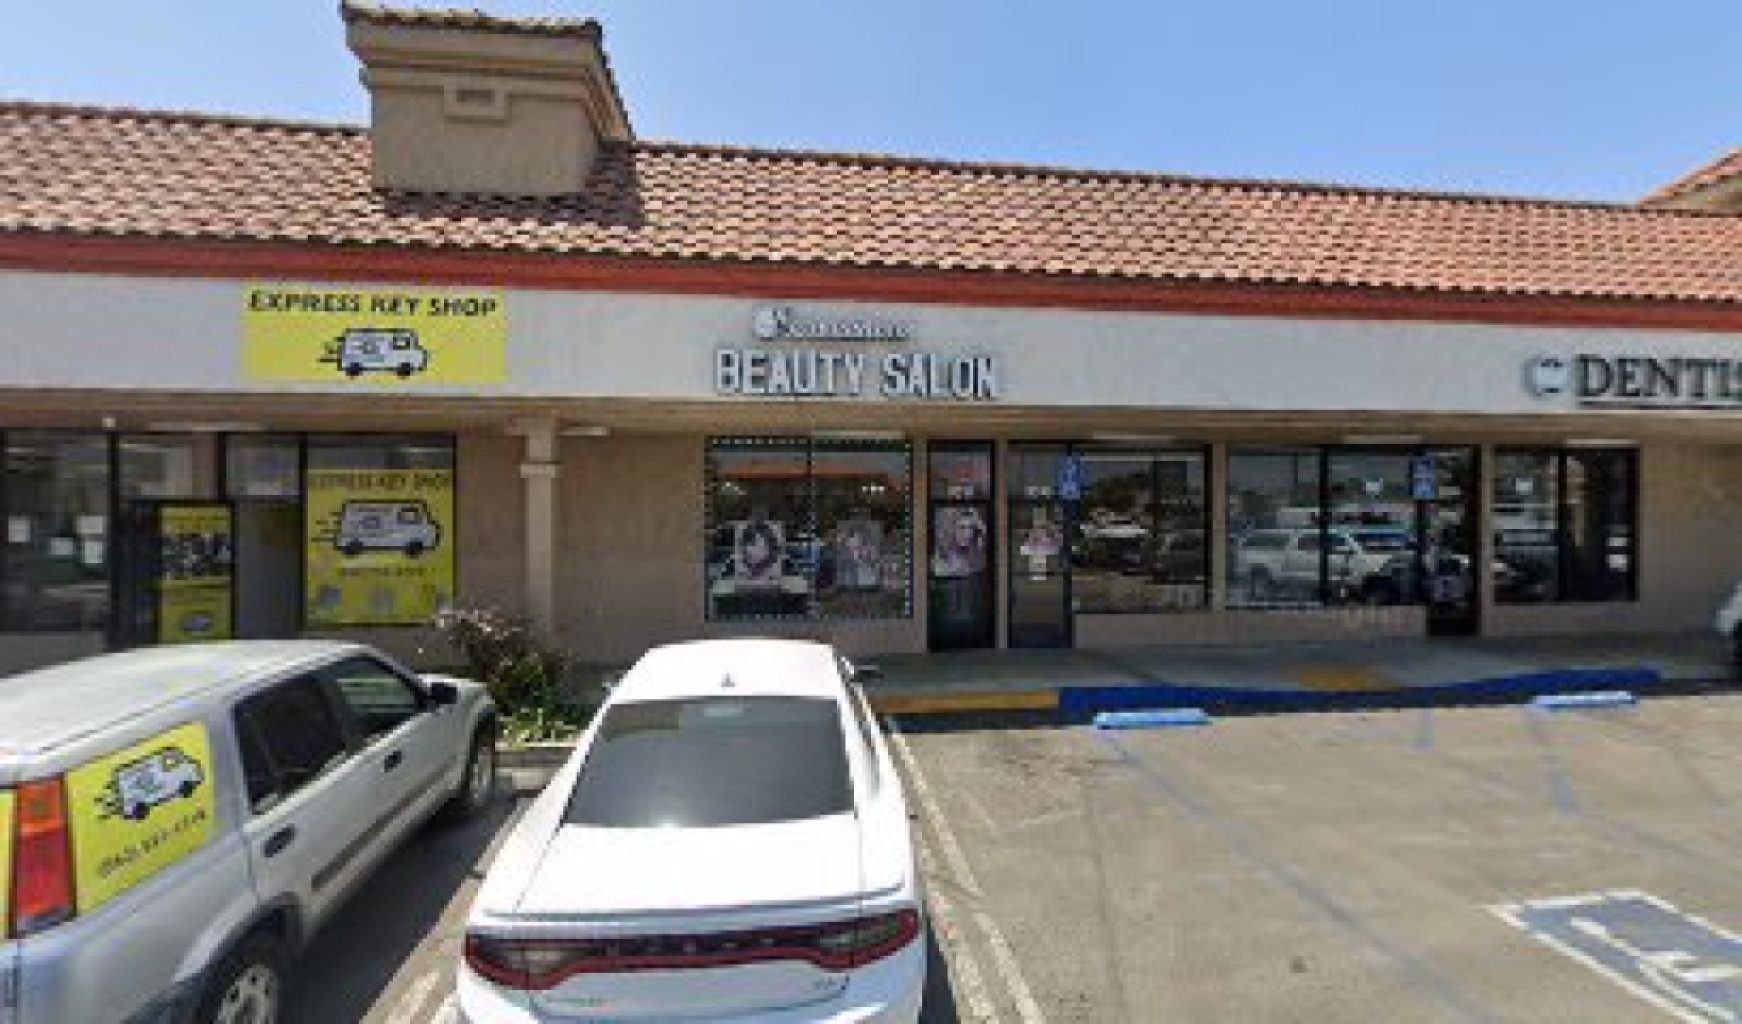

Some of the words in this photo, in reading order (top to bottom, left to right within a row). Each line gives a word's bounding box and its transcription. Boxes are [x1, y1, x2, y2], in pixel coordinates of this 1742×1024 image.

[248, 291, 361, 313] EXPRESS
[370, 297, 420, 316] KEY
[427, 298, 498, 318] SHOP
[716, 349, 864, 398] BEAUTY
[880, 352, 1001, 400] SALON
[1574, 353, 1742, 398] DENTI
